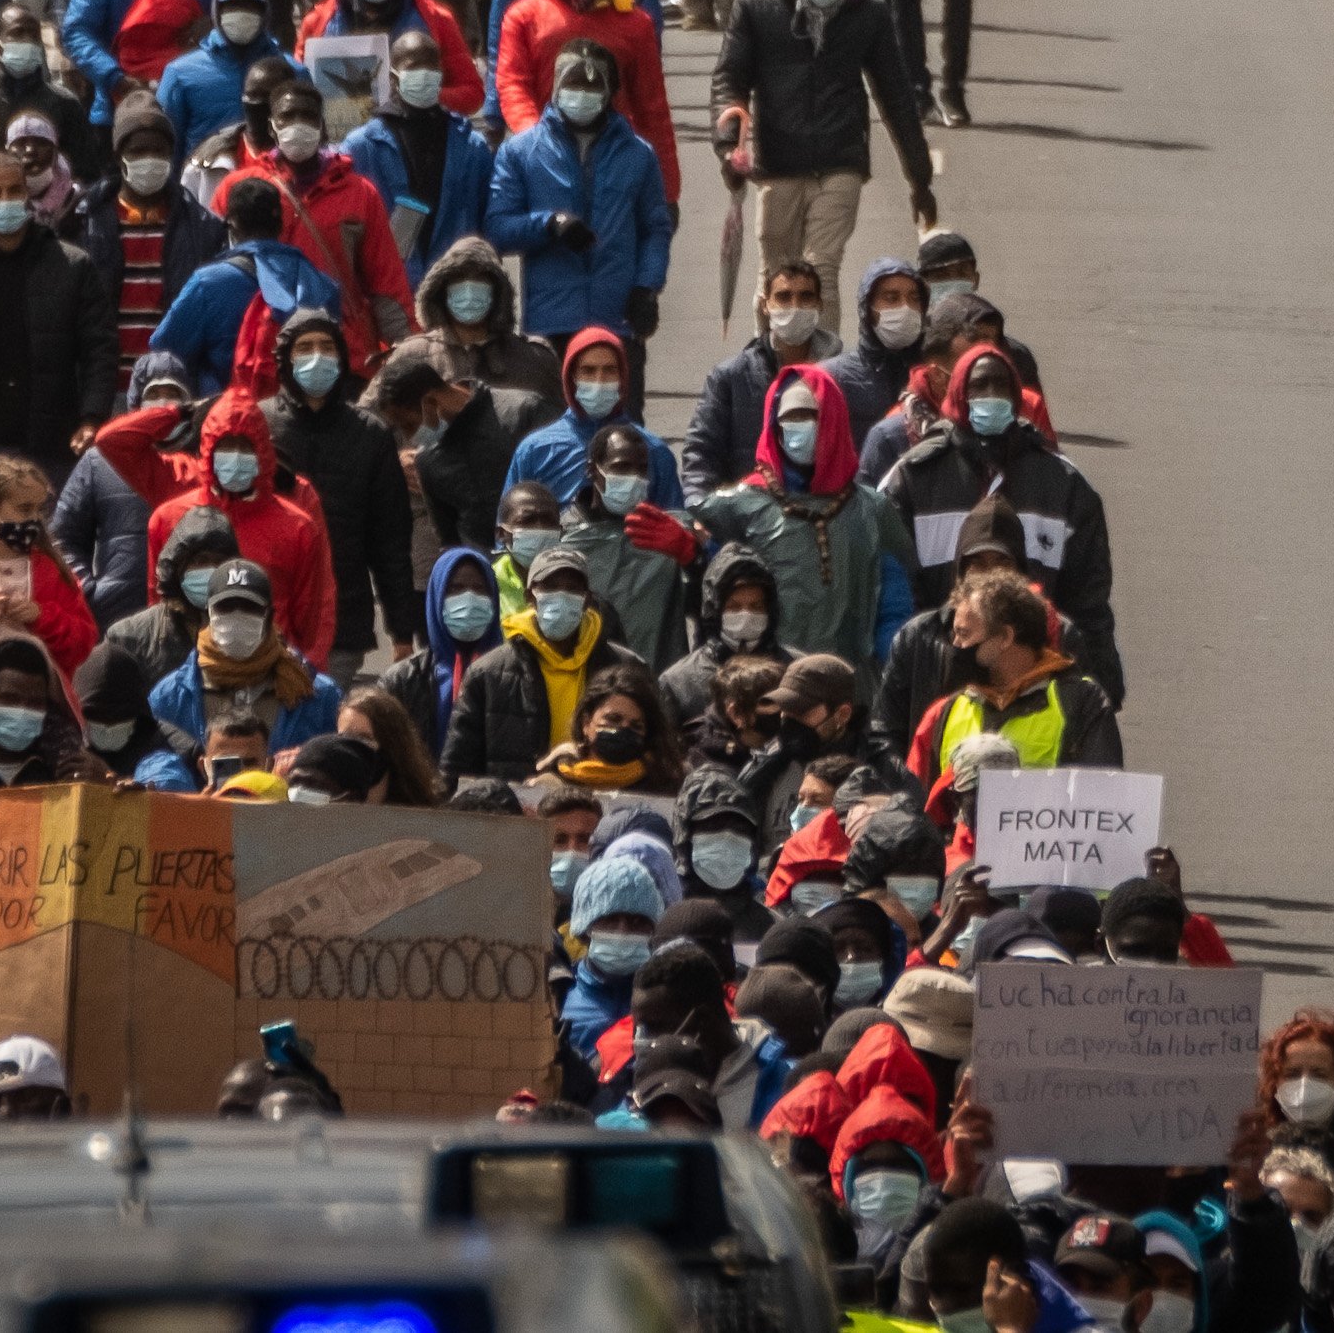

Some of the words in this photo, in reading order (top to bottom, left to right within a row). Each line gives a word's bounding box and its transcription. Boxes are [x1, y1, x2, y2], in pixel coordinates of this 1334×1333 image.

[998, 808, 1135, 835] FRONTEX
[39, 842, 90, 886] LAS
[105, 844, 236, 896] PUERTAS
[1024, 840, 1103, 865] MATA
[134, 893, 237, 948] FAVOR
[1082, 975, 1162, 1005] contra
[1168, 980, 1187, 1004] la
[1123, 1004, 1253, 1038] ignorancia
[1167, 1025, 1260, 1057] libertad
[1130, 1104, 1222, 1141] VIDA
